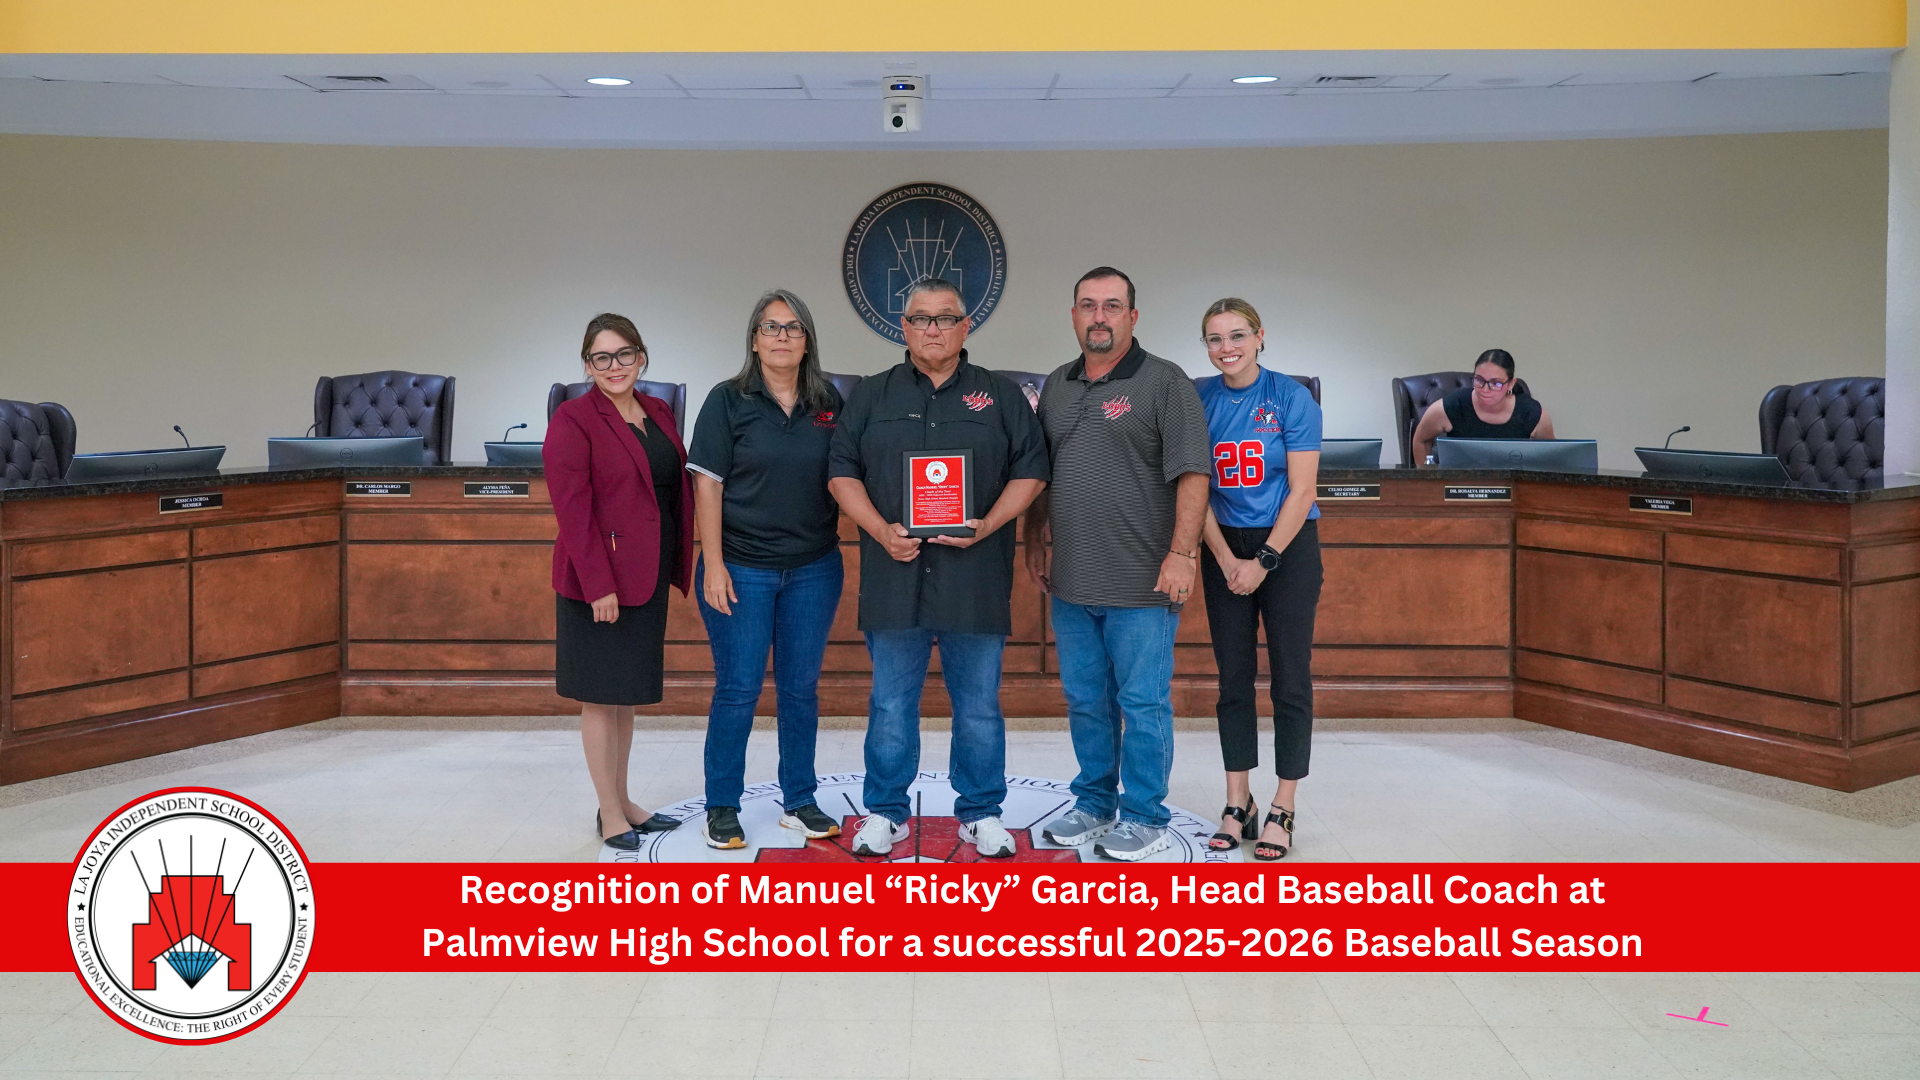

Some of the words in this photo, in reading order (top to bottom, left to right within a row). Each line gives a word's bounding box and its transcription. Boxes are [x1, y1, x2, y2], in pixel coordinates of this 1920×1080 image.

[859, 210, 875, 233] JOYA
[874, 186, 936, 213] INDEPENDENT
[937, 189, 972, 211] SCHOOL
[972, 208, 1000, 246] DISTRICT
[846, 254, 867, 315] EDUCATIONAL
[978, 297, 996, 322] EVERY
[991, 257, 1003, 298] STUDENT
[1213, 440, 1264, 488] 26
